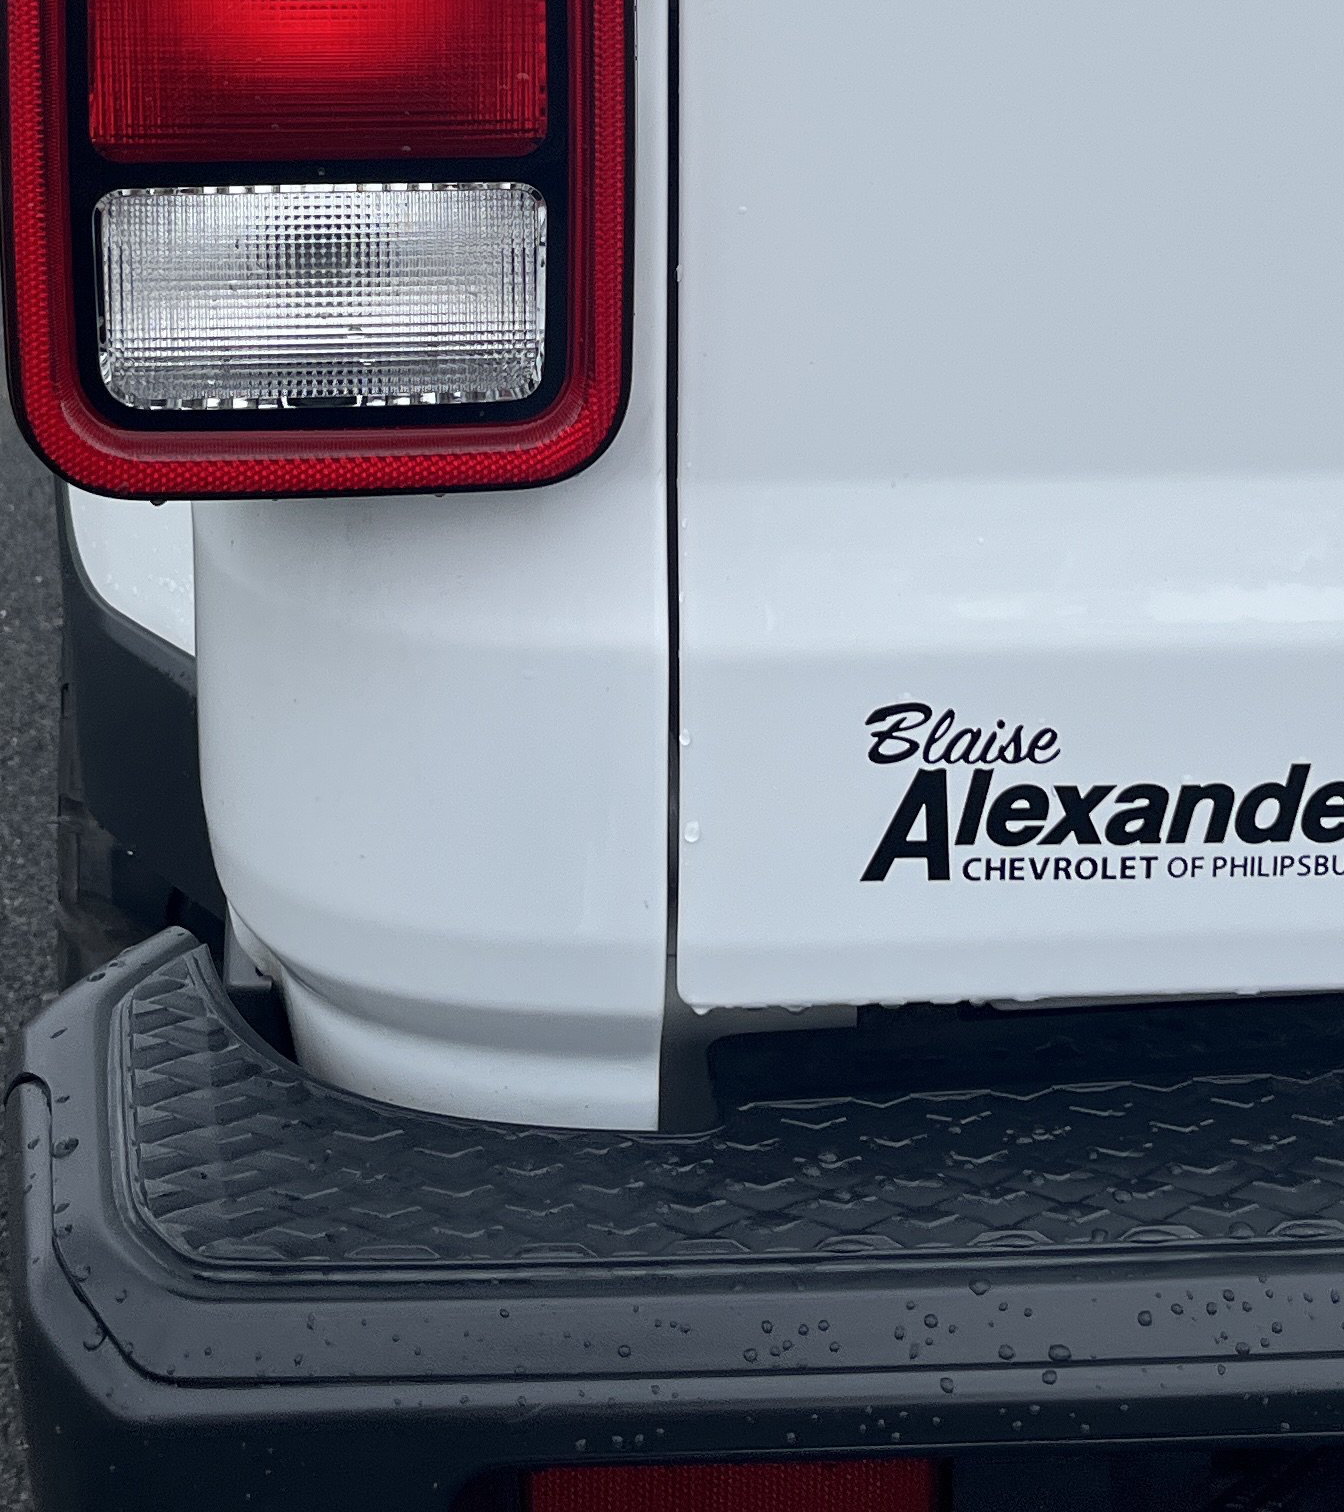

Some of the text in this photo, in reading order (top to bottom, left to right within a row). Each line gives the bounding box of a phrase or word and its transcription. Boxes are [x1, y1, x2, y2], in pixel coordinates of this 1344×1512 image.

[864, 702, 1061, 765] Blaise
[962, 856, 1159, 882] CHEVROLET
[1167, 855, 1205, 879] OF
